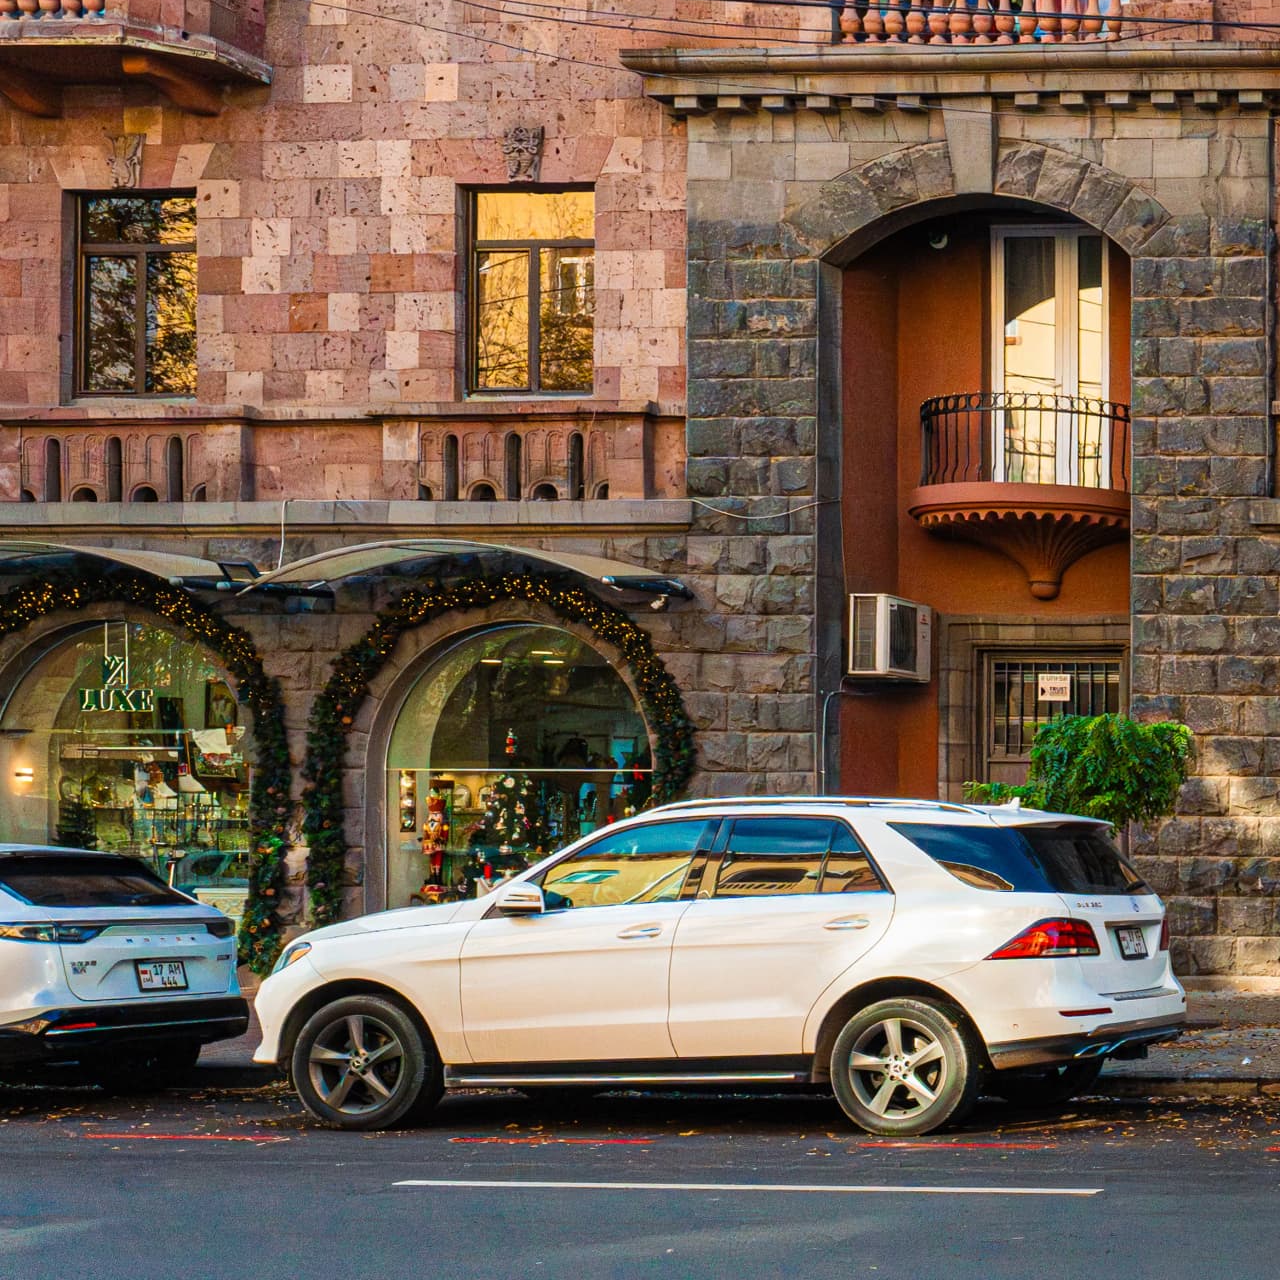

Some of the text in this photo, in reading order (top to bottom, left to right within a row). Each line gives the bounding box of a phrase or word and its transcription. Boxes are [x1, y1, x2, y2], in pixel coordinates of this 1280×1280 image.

[80, 688, 154, 712] LUXE
[153, 963, 164, 976] 17
[161, 976, 179, 987] 444
